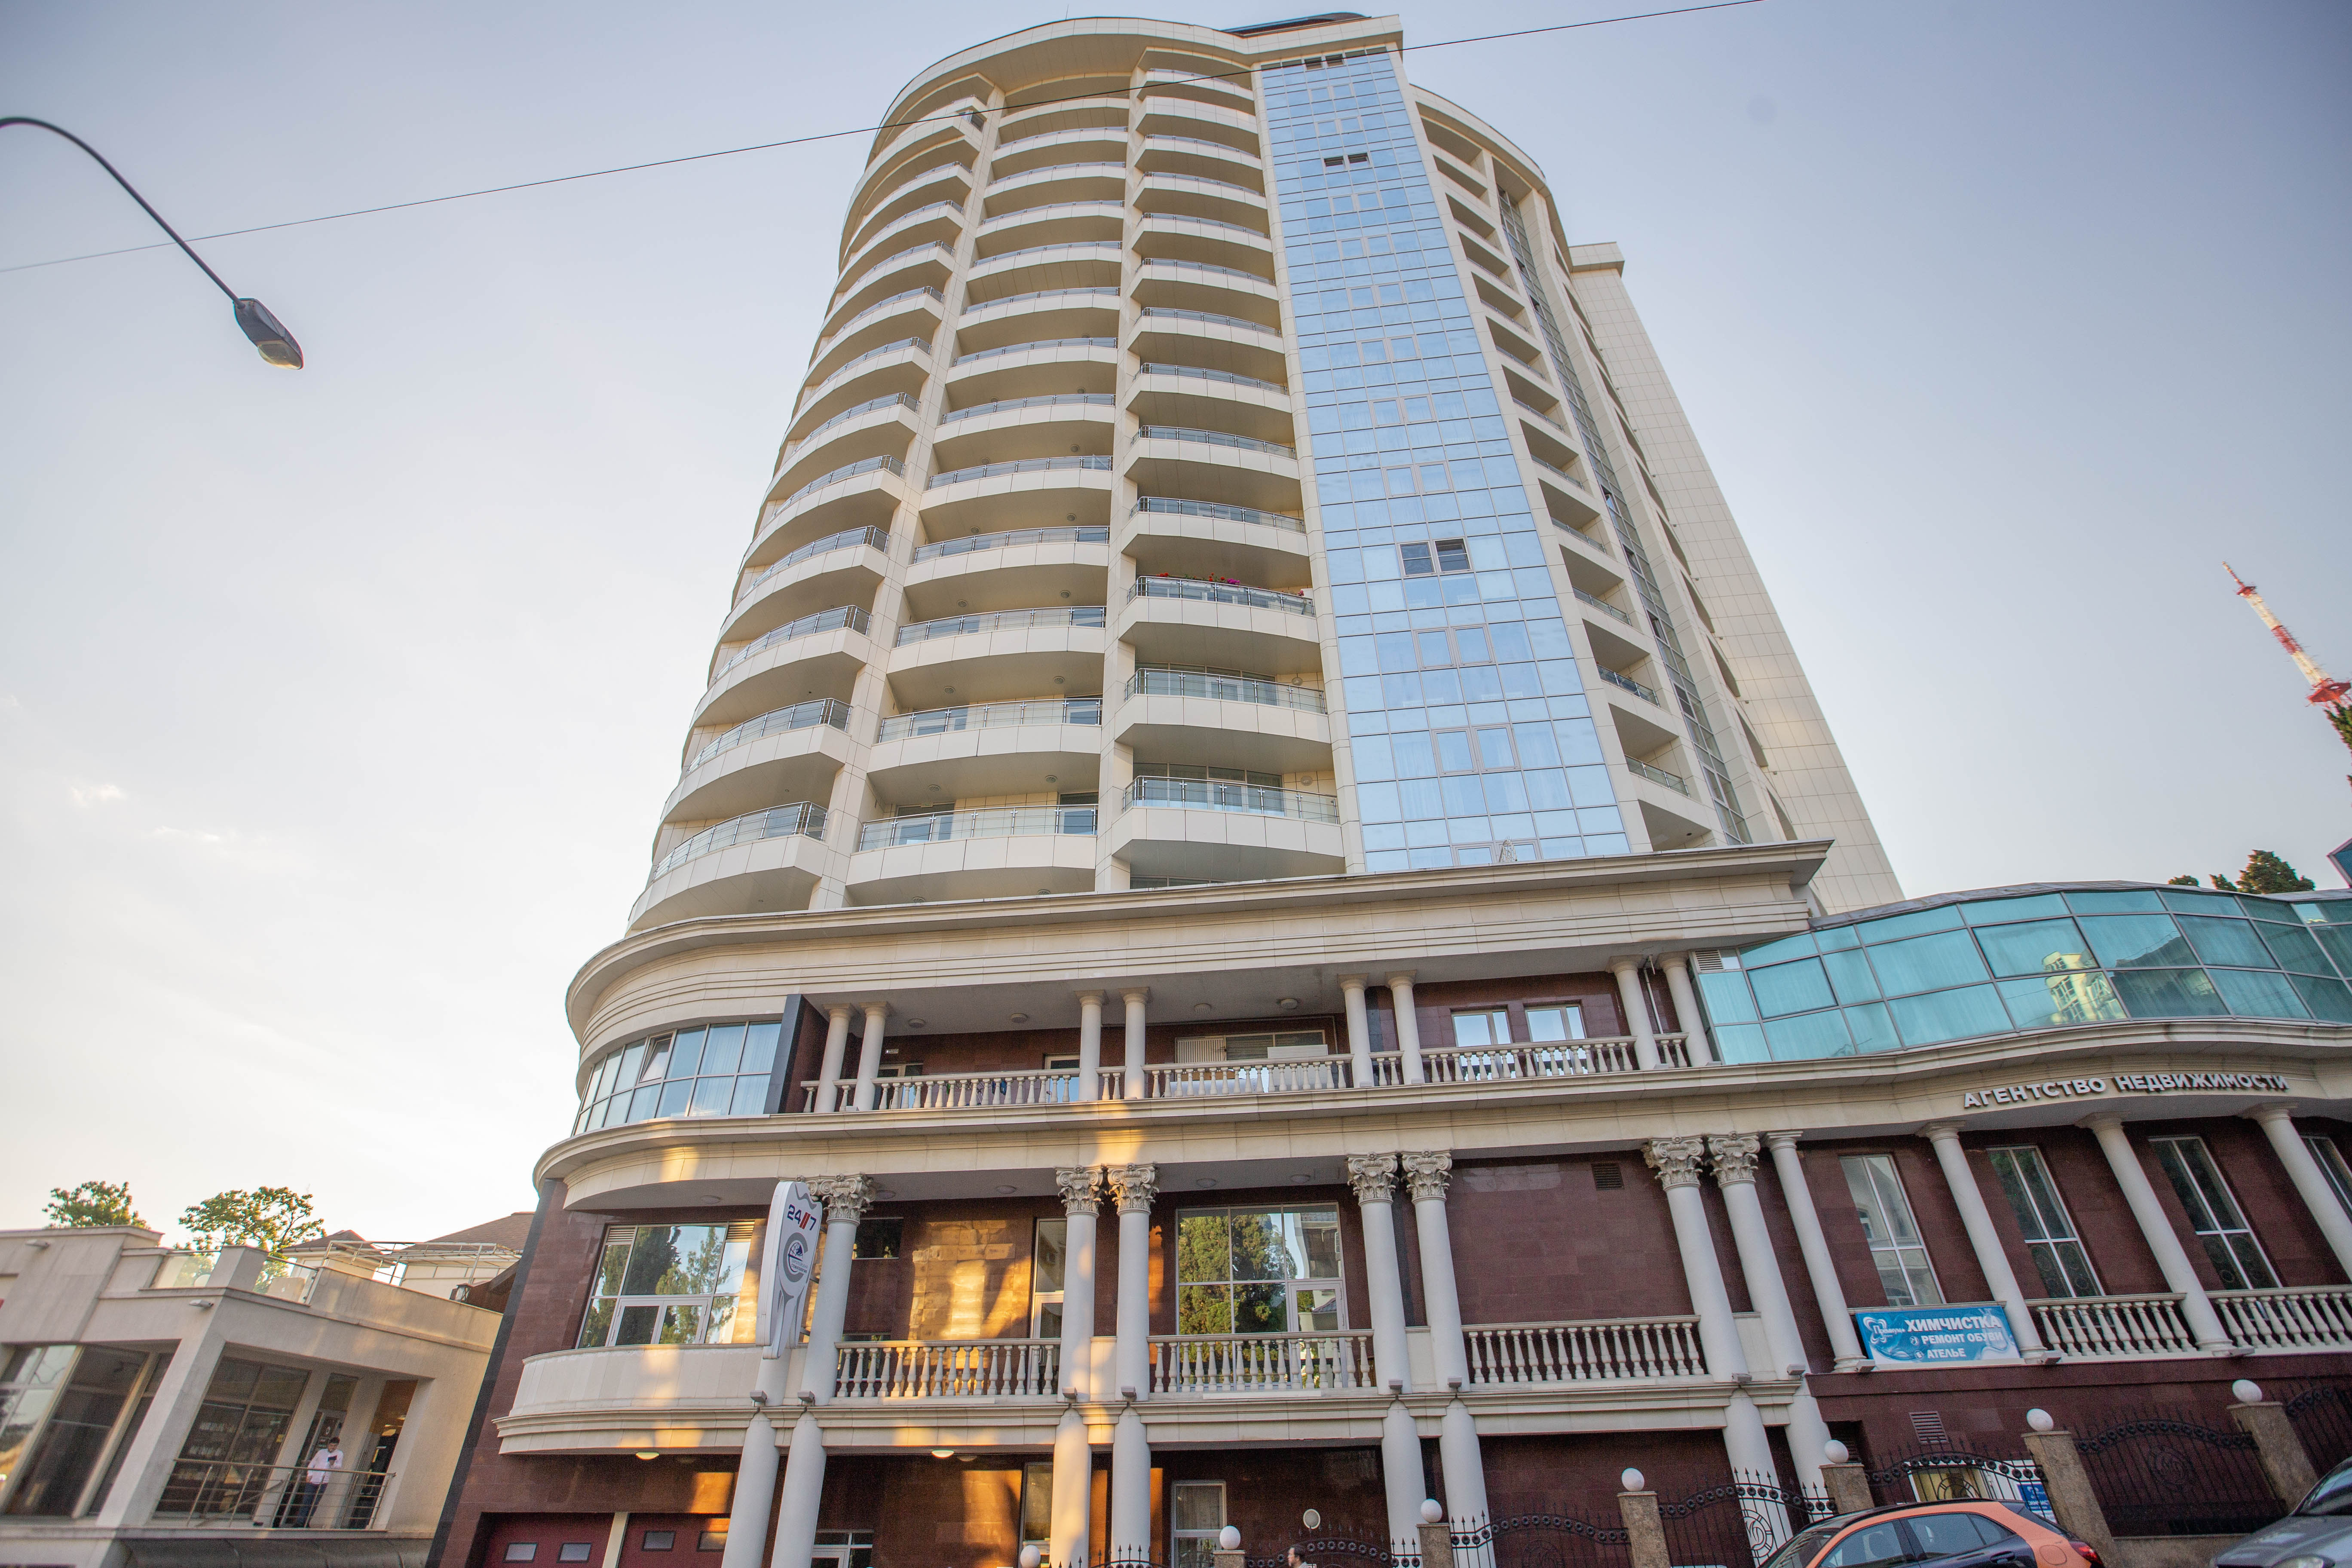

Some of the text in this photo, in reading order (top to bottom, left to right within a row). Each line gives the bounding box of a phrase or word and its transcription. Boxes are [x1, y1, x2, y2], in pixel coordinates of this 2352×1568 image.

[1964, 1073, 2289, 1109] АГЕНТСТВО НЕДВИЖИМОСТИ
[1905, 1316, 2002, 1332] ХИМЧИСТКА
[1921, 1332, 2004, 1345] РЕМОНТ ОБУВИ
[1927, 1348, 1966, 1359] АТЕЛЬЕ
